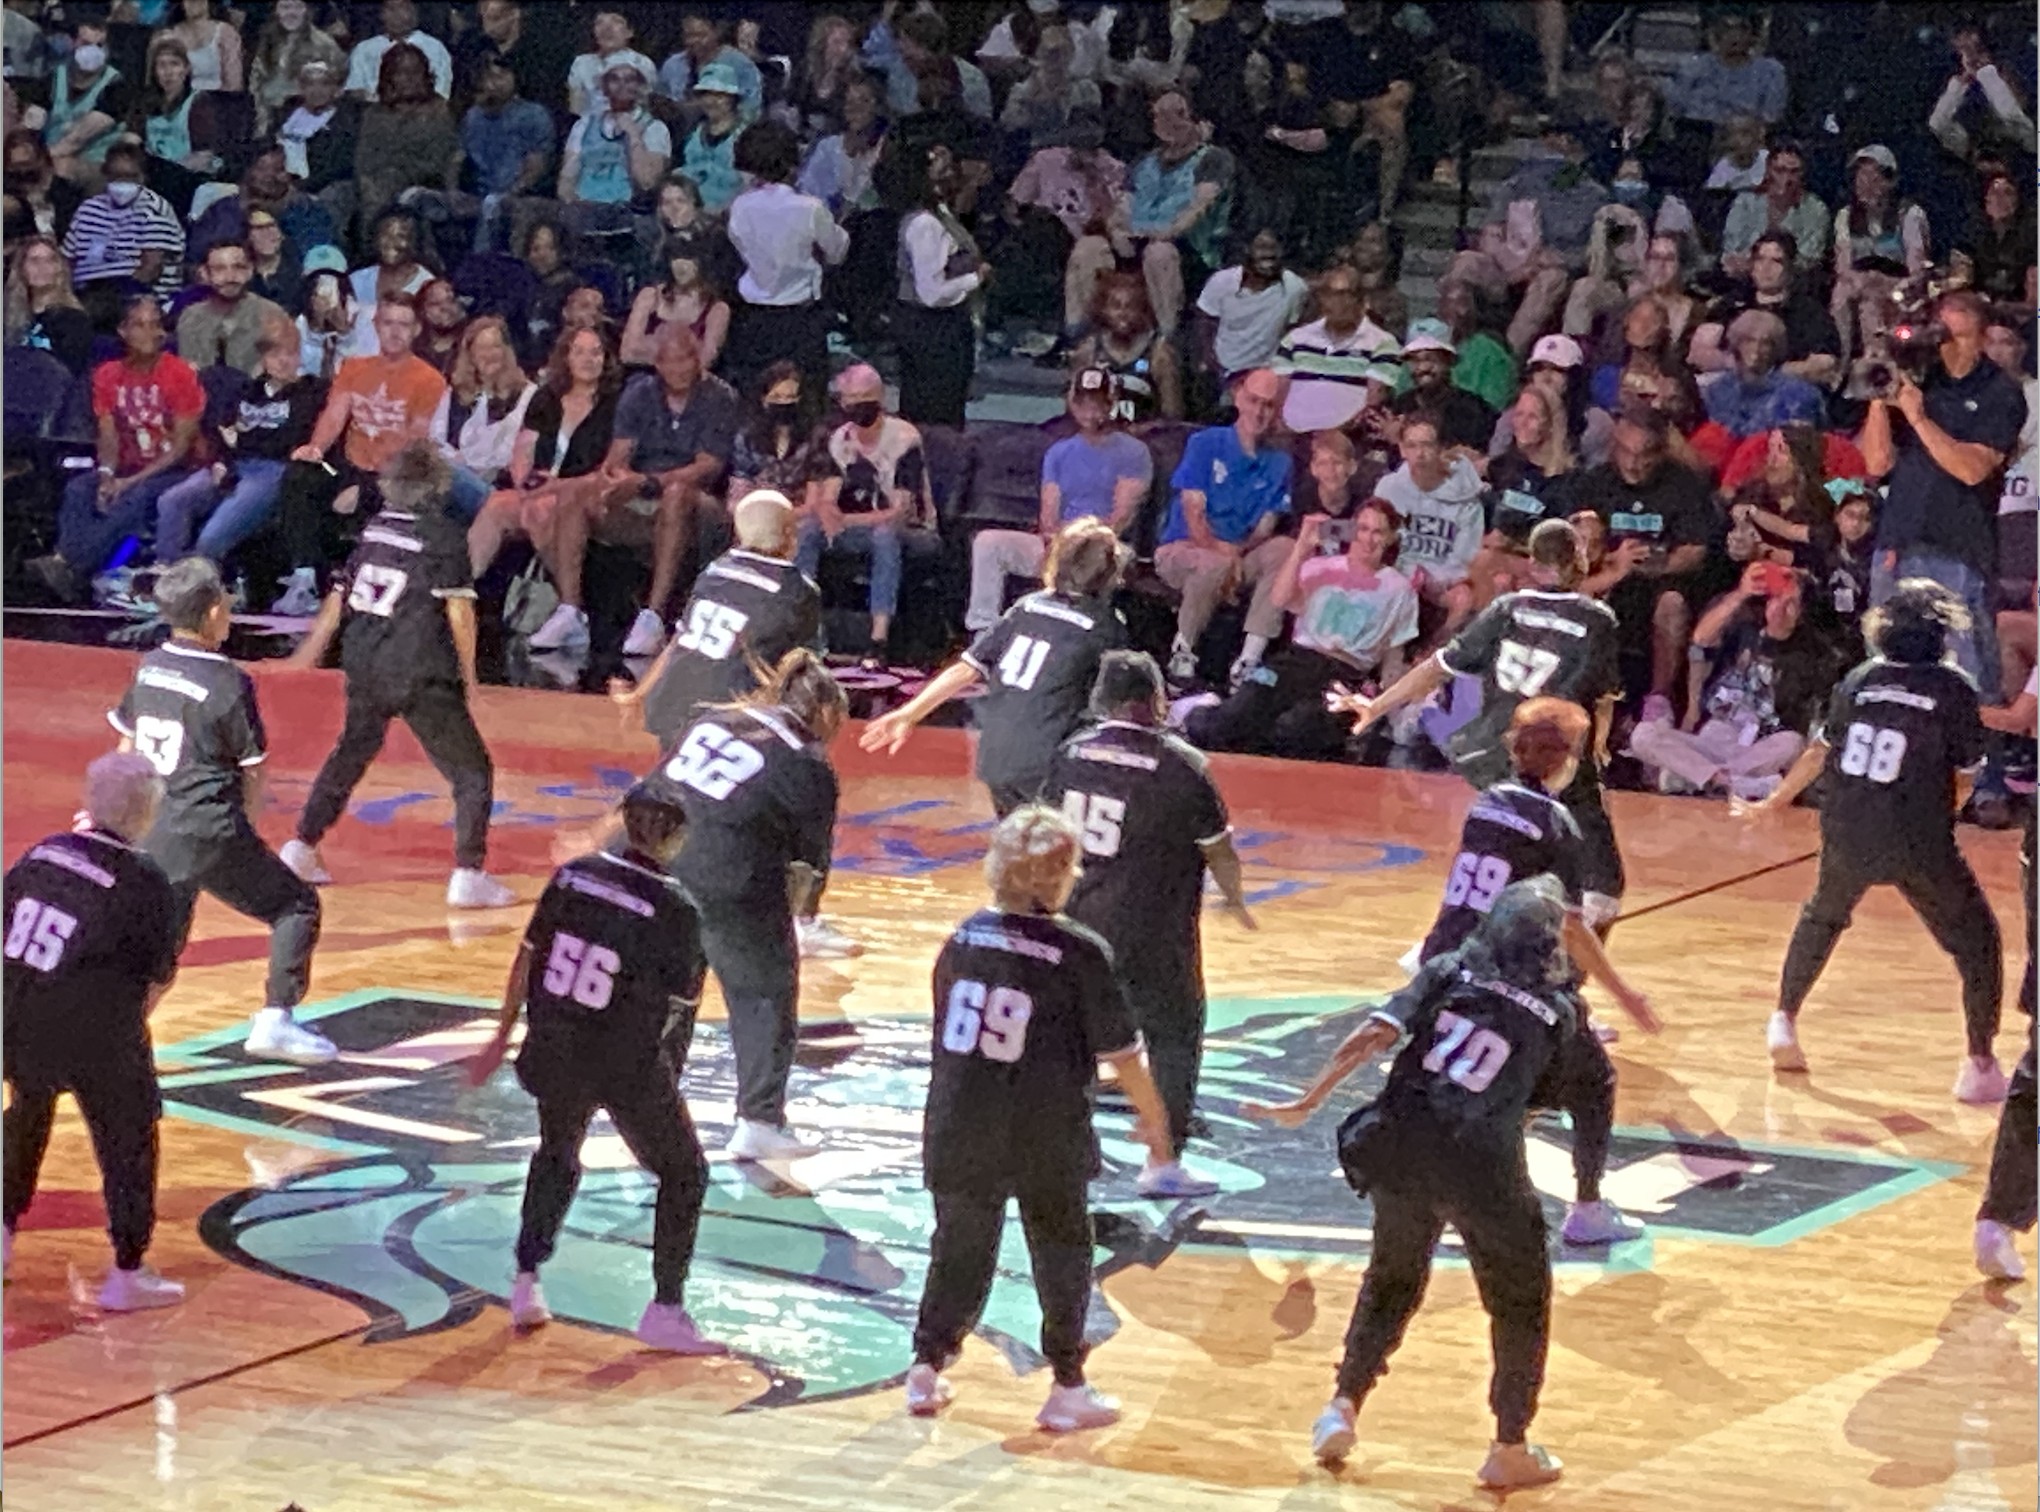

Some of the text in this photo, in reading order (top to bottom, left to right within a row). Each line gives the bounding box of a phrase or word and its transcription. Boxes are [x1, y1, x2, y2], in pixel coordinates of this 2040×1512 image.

[348, 563, 408, 617] 57
[678, 599, 749, 660] 55
[999, 634, 1050, 687] 41
[1496, 639, 1560, 697] 57
[665, 722, 765, 800] 52
[1840, 722, 1908, 784] 68
[1444, 851, 1512, 914] 69
[542, 931, 621, 1010] 56
[942, 978, 1033, 1063] 69
[1421, 1009, 1512, 1093] 70
